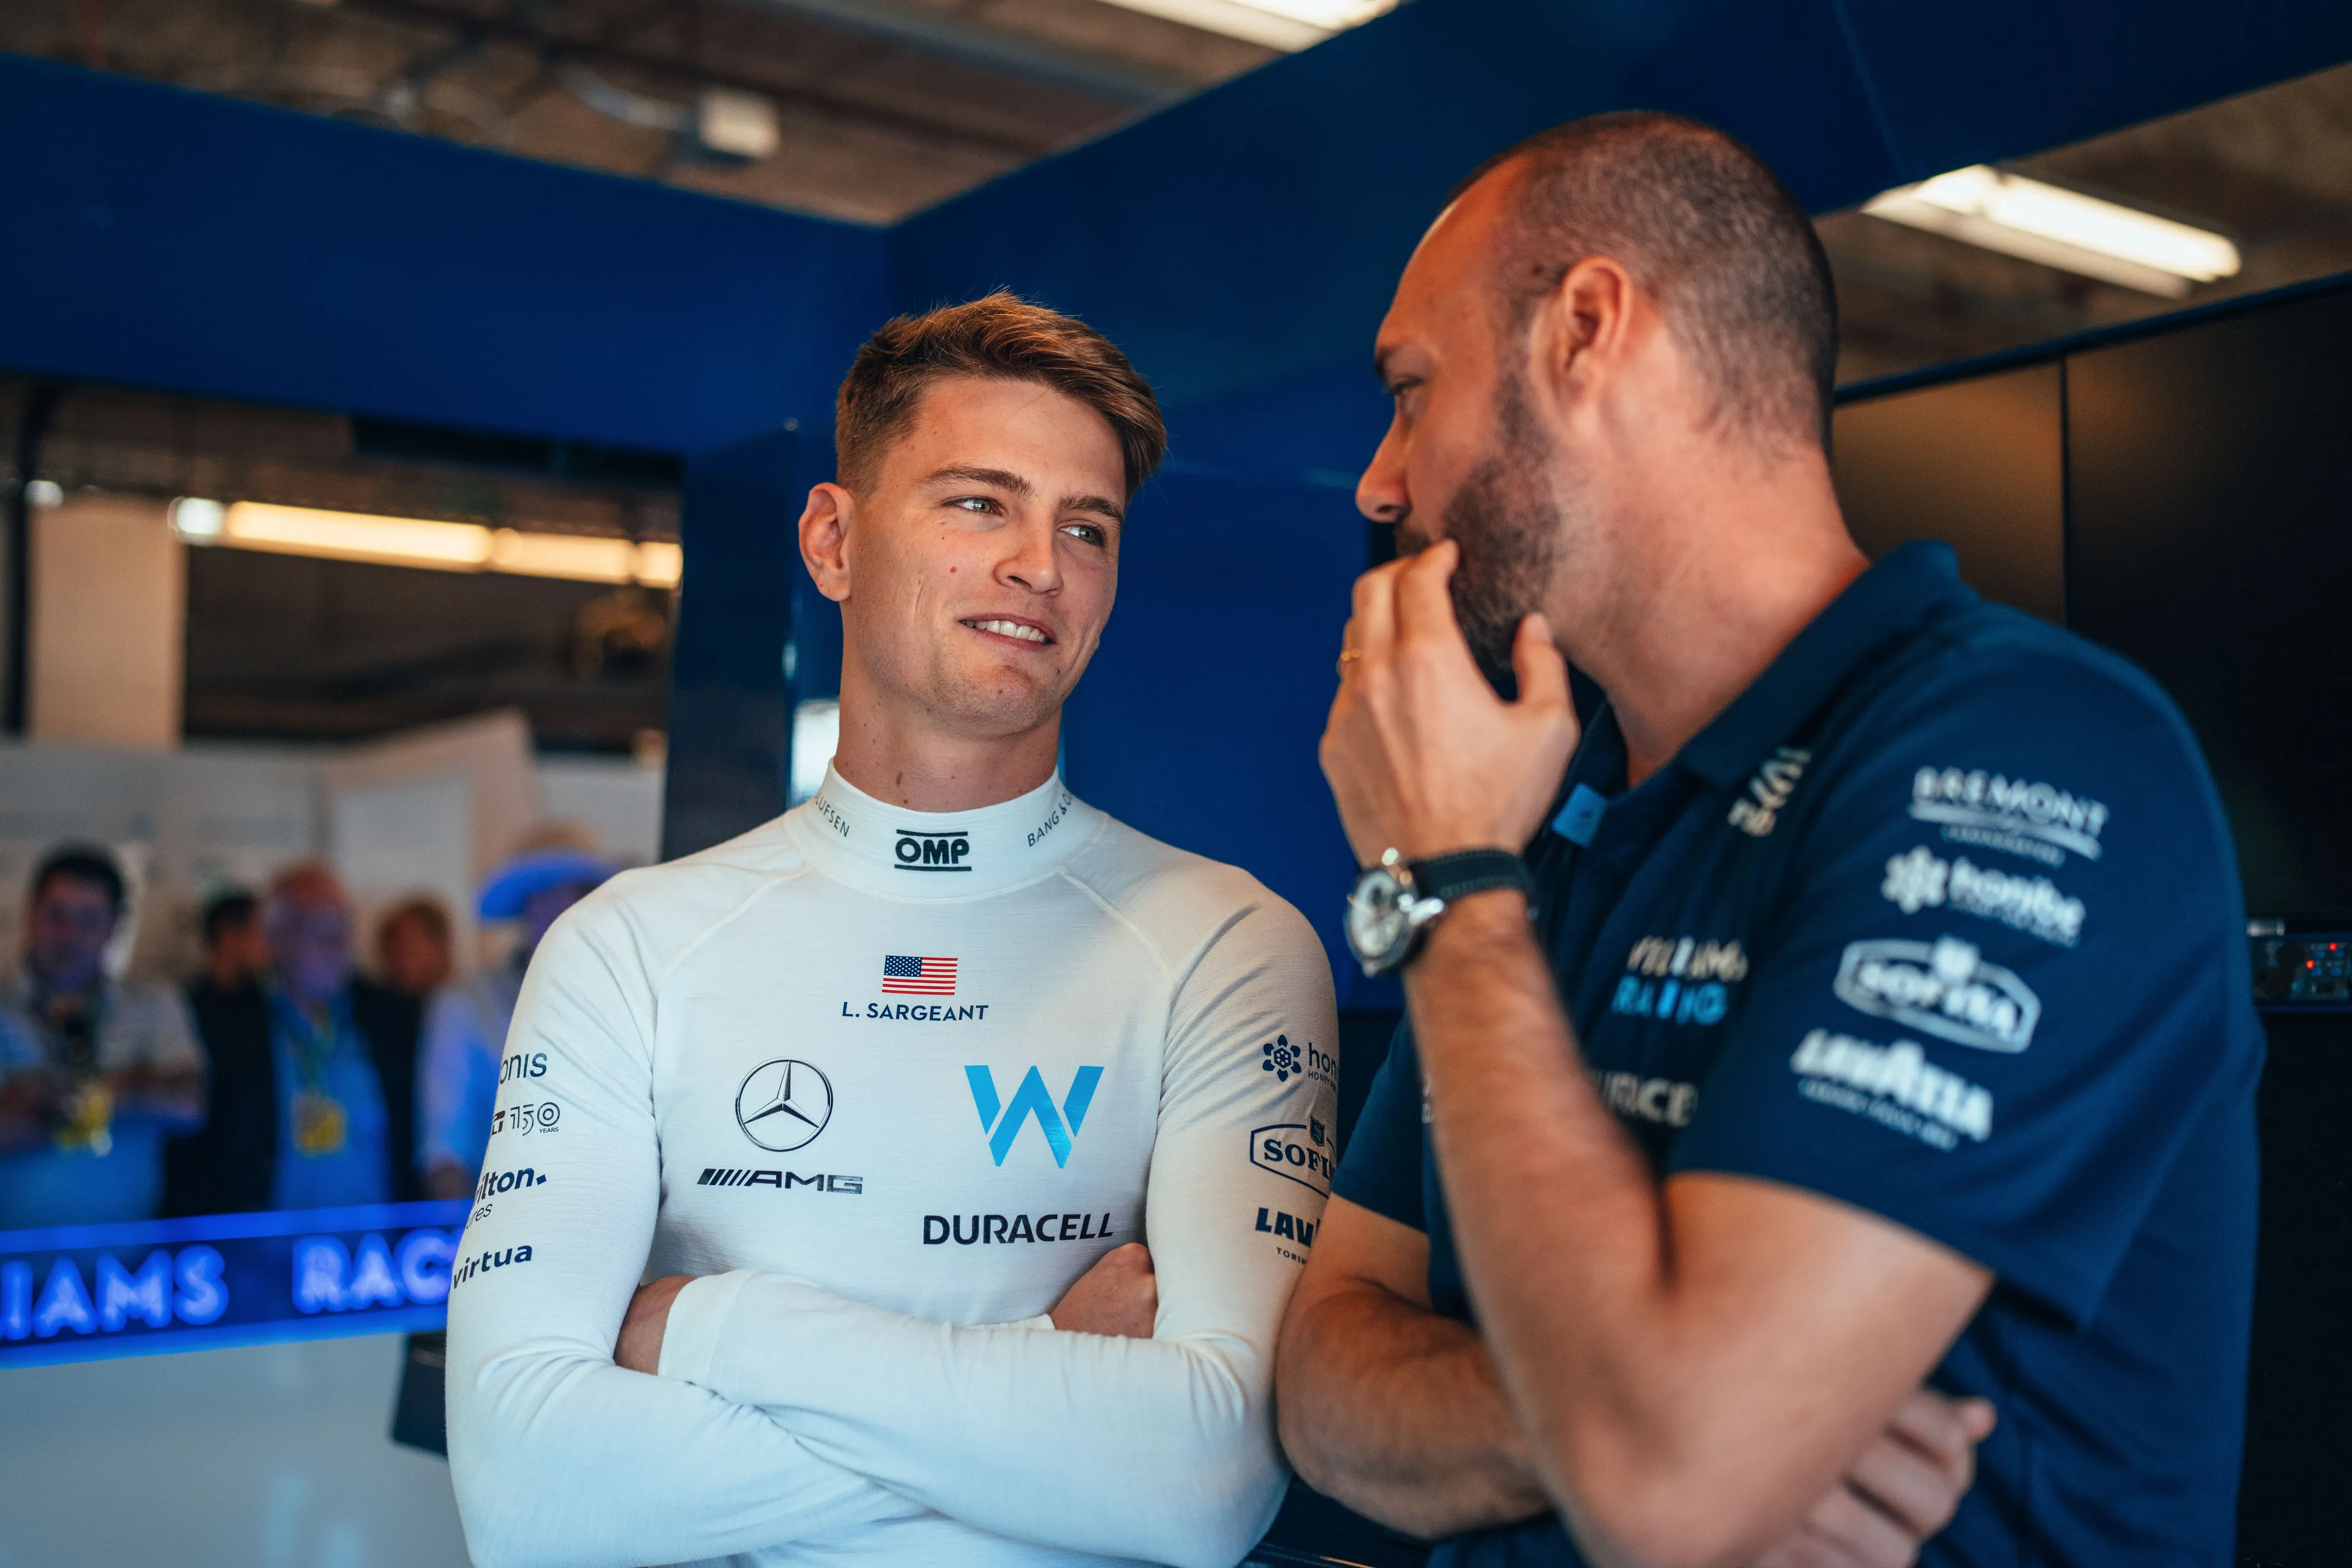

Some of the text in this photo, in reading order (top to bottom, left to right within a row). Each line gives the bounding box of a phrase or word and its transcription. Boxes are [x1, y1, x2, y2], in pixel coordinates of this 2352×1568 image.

[1027, 810, 1060, 847] BANG
[1058, 802, 1067, 815] &
[895, 837, 970, 865] OMP
[841, 1001, 989, 1022] L. SARGEANT
[745, 1169, 864, 1195] AMG
[922, 1212, 1115, 1245] DURACELL
[1255, 1207, 1321, 1248] LAV
[453, 1245, 533, 1290] virtua
[0, 1243, 229, 1340] IAMS
